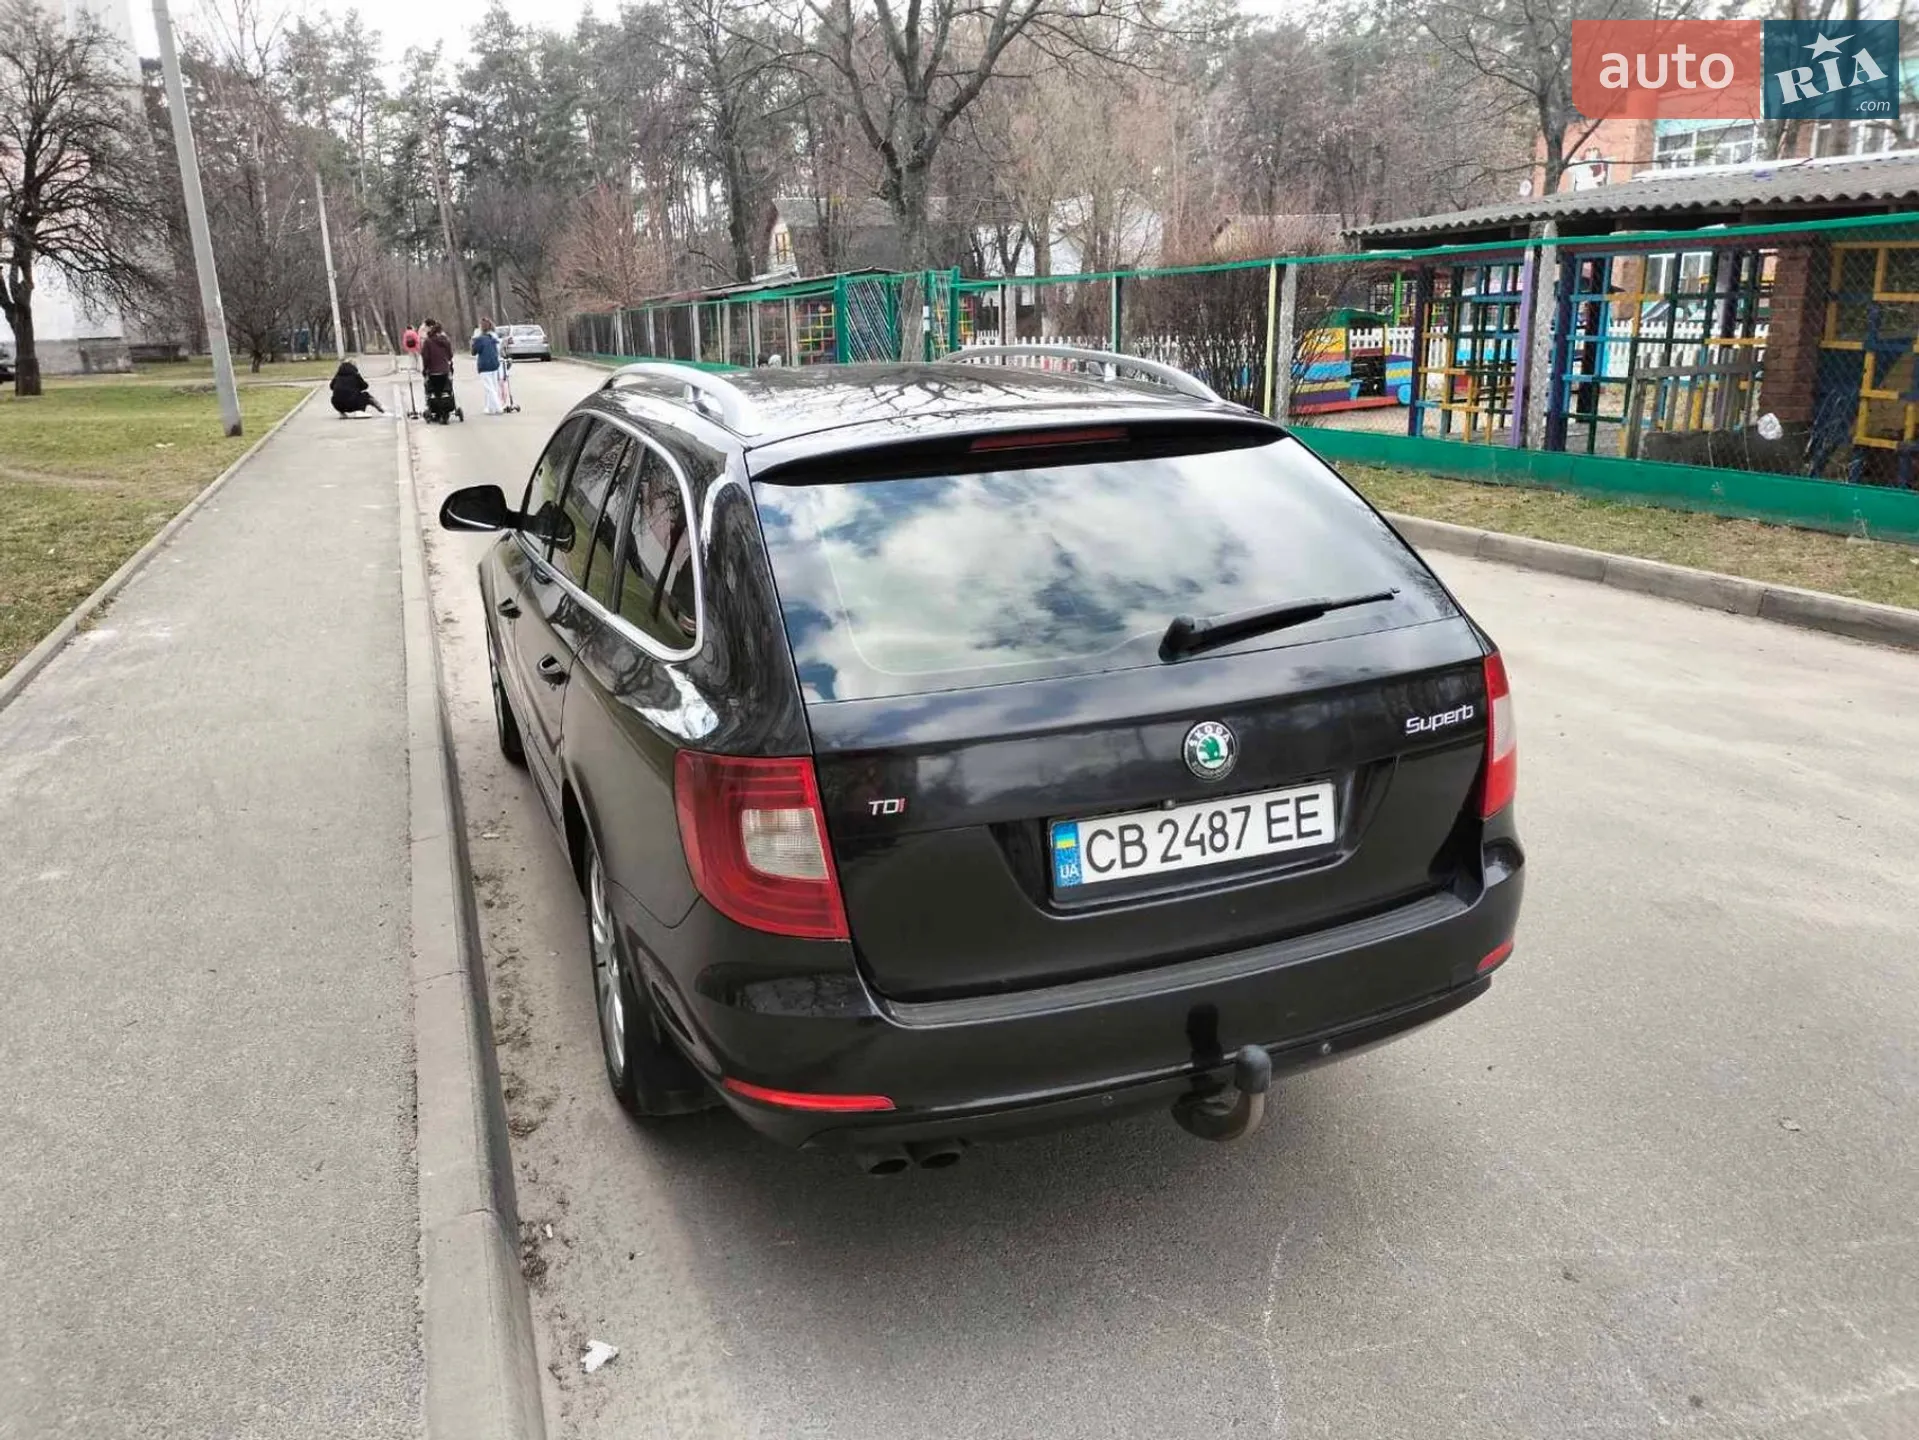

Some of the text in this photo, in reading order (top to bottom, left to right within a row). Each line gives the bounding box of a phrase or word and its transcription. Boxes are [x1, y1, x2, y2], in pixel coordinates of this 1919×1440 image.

[1405, 704, 1474, 735] Superb
[1085, 793, 1323, 873] CB 2487 EE
[1060, 863, 1080, 879] UA
